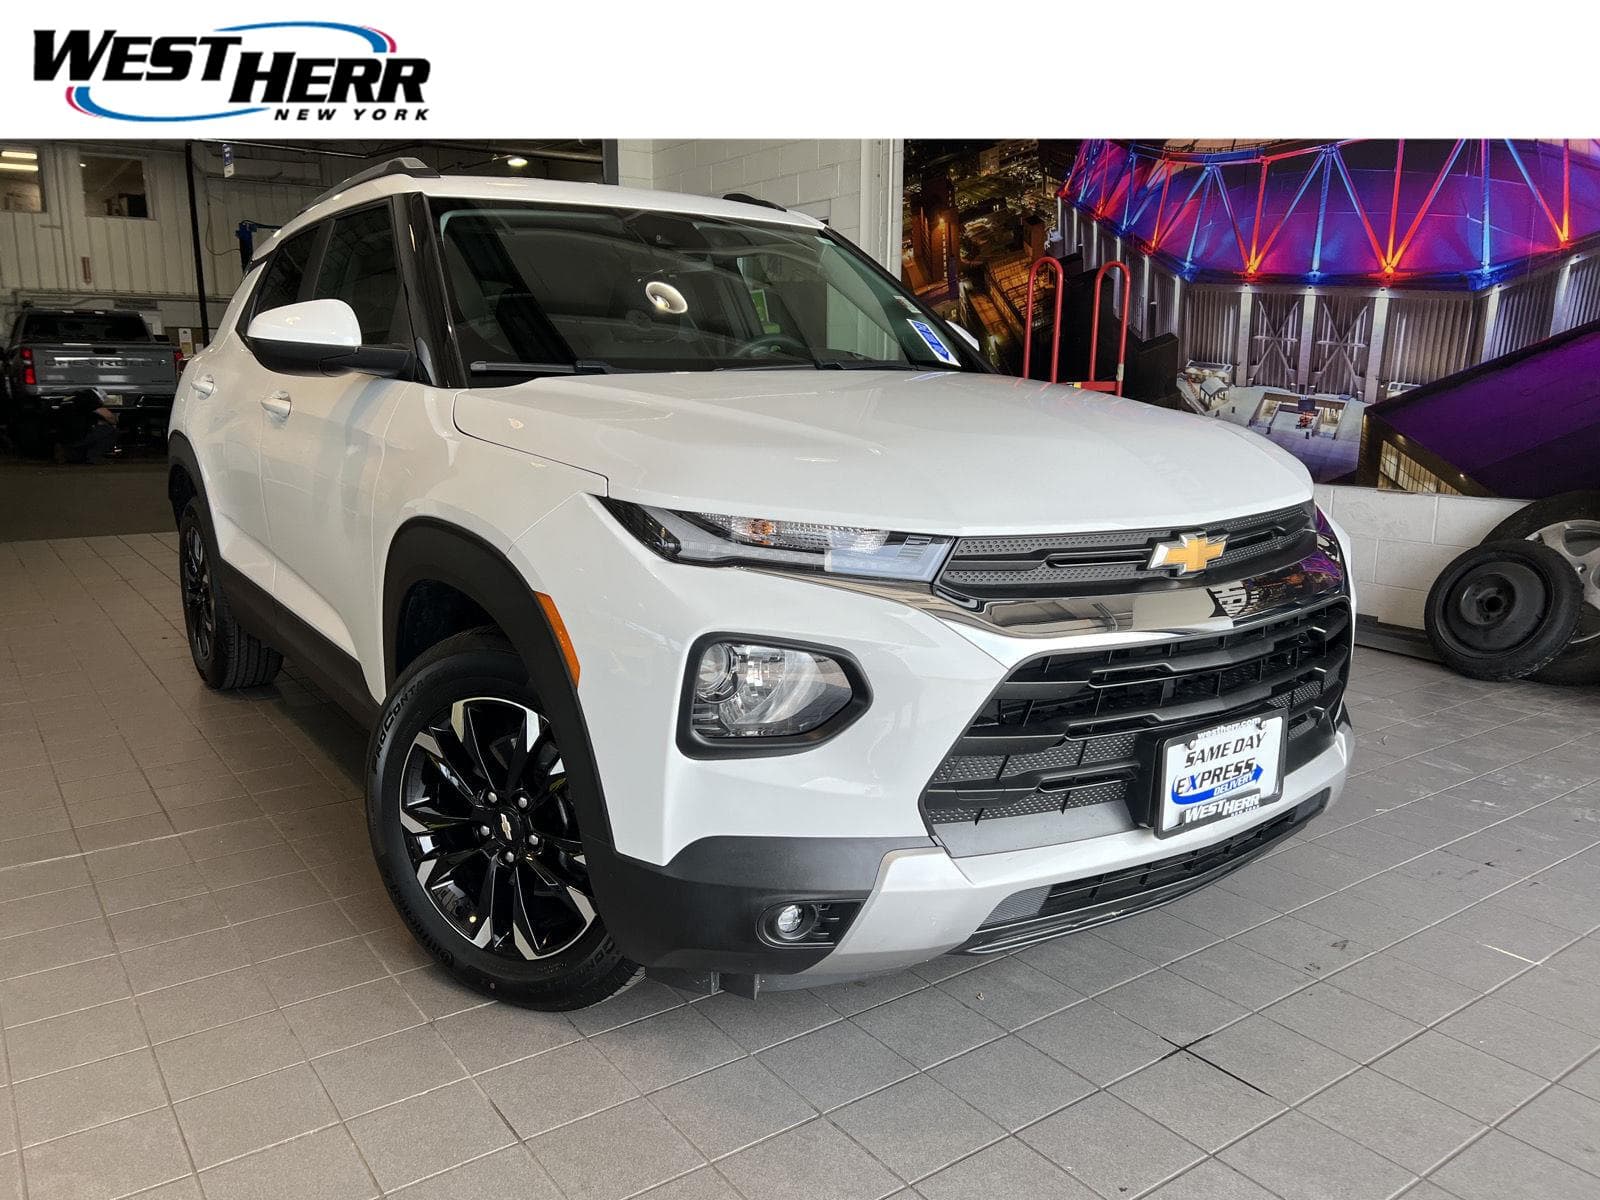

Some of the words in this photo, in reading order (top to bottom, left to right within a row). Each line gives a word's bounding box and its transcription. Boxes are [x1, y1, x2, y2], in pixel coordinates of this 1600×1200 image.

[1197, 716, 1262, 739] westherr.com
[1184, 741, 1232, 769] SAME
[1232, 731, 1267, 755] DAY
[1175, 757, 1256, 796] EXPRESS
[1213, 772, 1255, 797] DELIVERY
